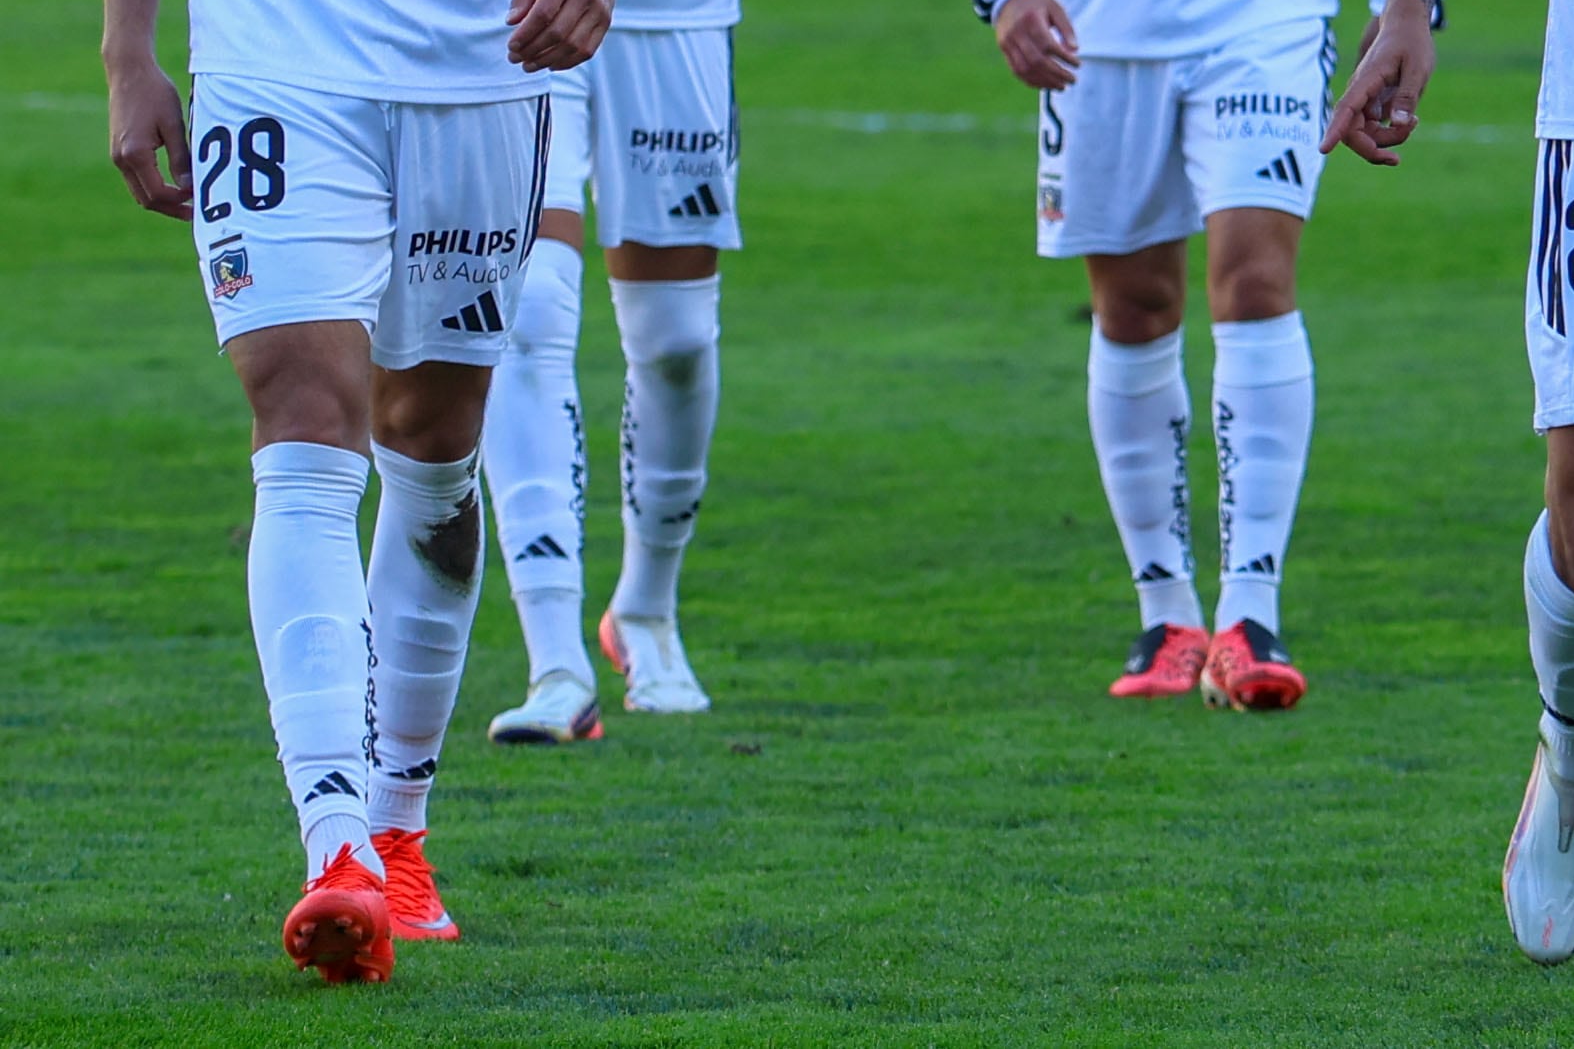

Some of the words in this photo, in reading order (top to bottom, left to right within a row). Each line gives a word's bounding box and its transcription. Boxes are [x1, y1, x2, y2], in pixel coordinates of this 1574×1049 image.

[1216, 94, 1311, 122] PHILIPS
[631, 129, 724, 154] PHILIPS
[198, 116, 287, 224] 28
[408, 228, 518, 258] PHILIPS
[407, 261, 430, 285] TV
[433, 261, 447, 281] &
